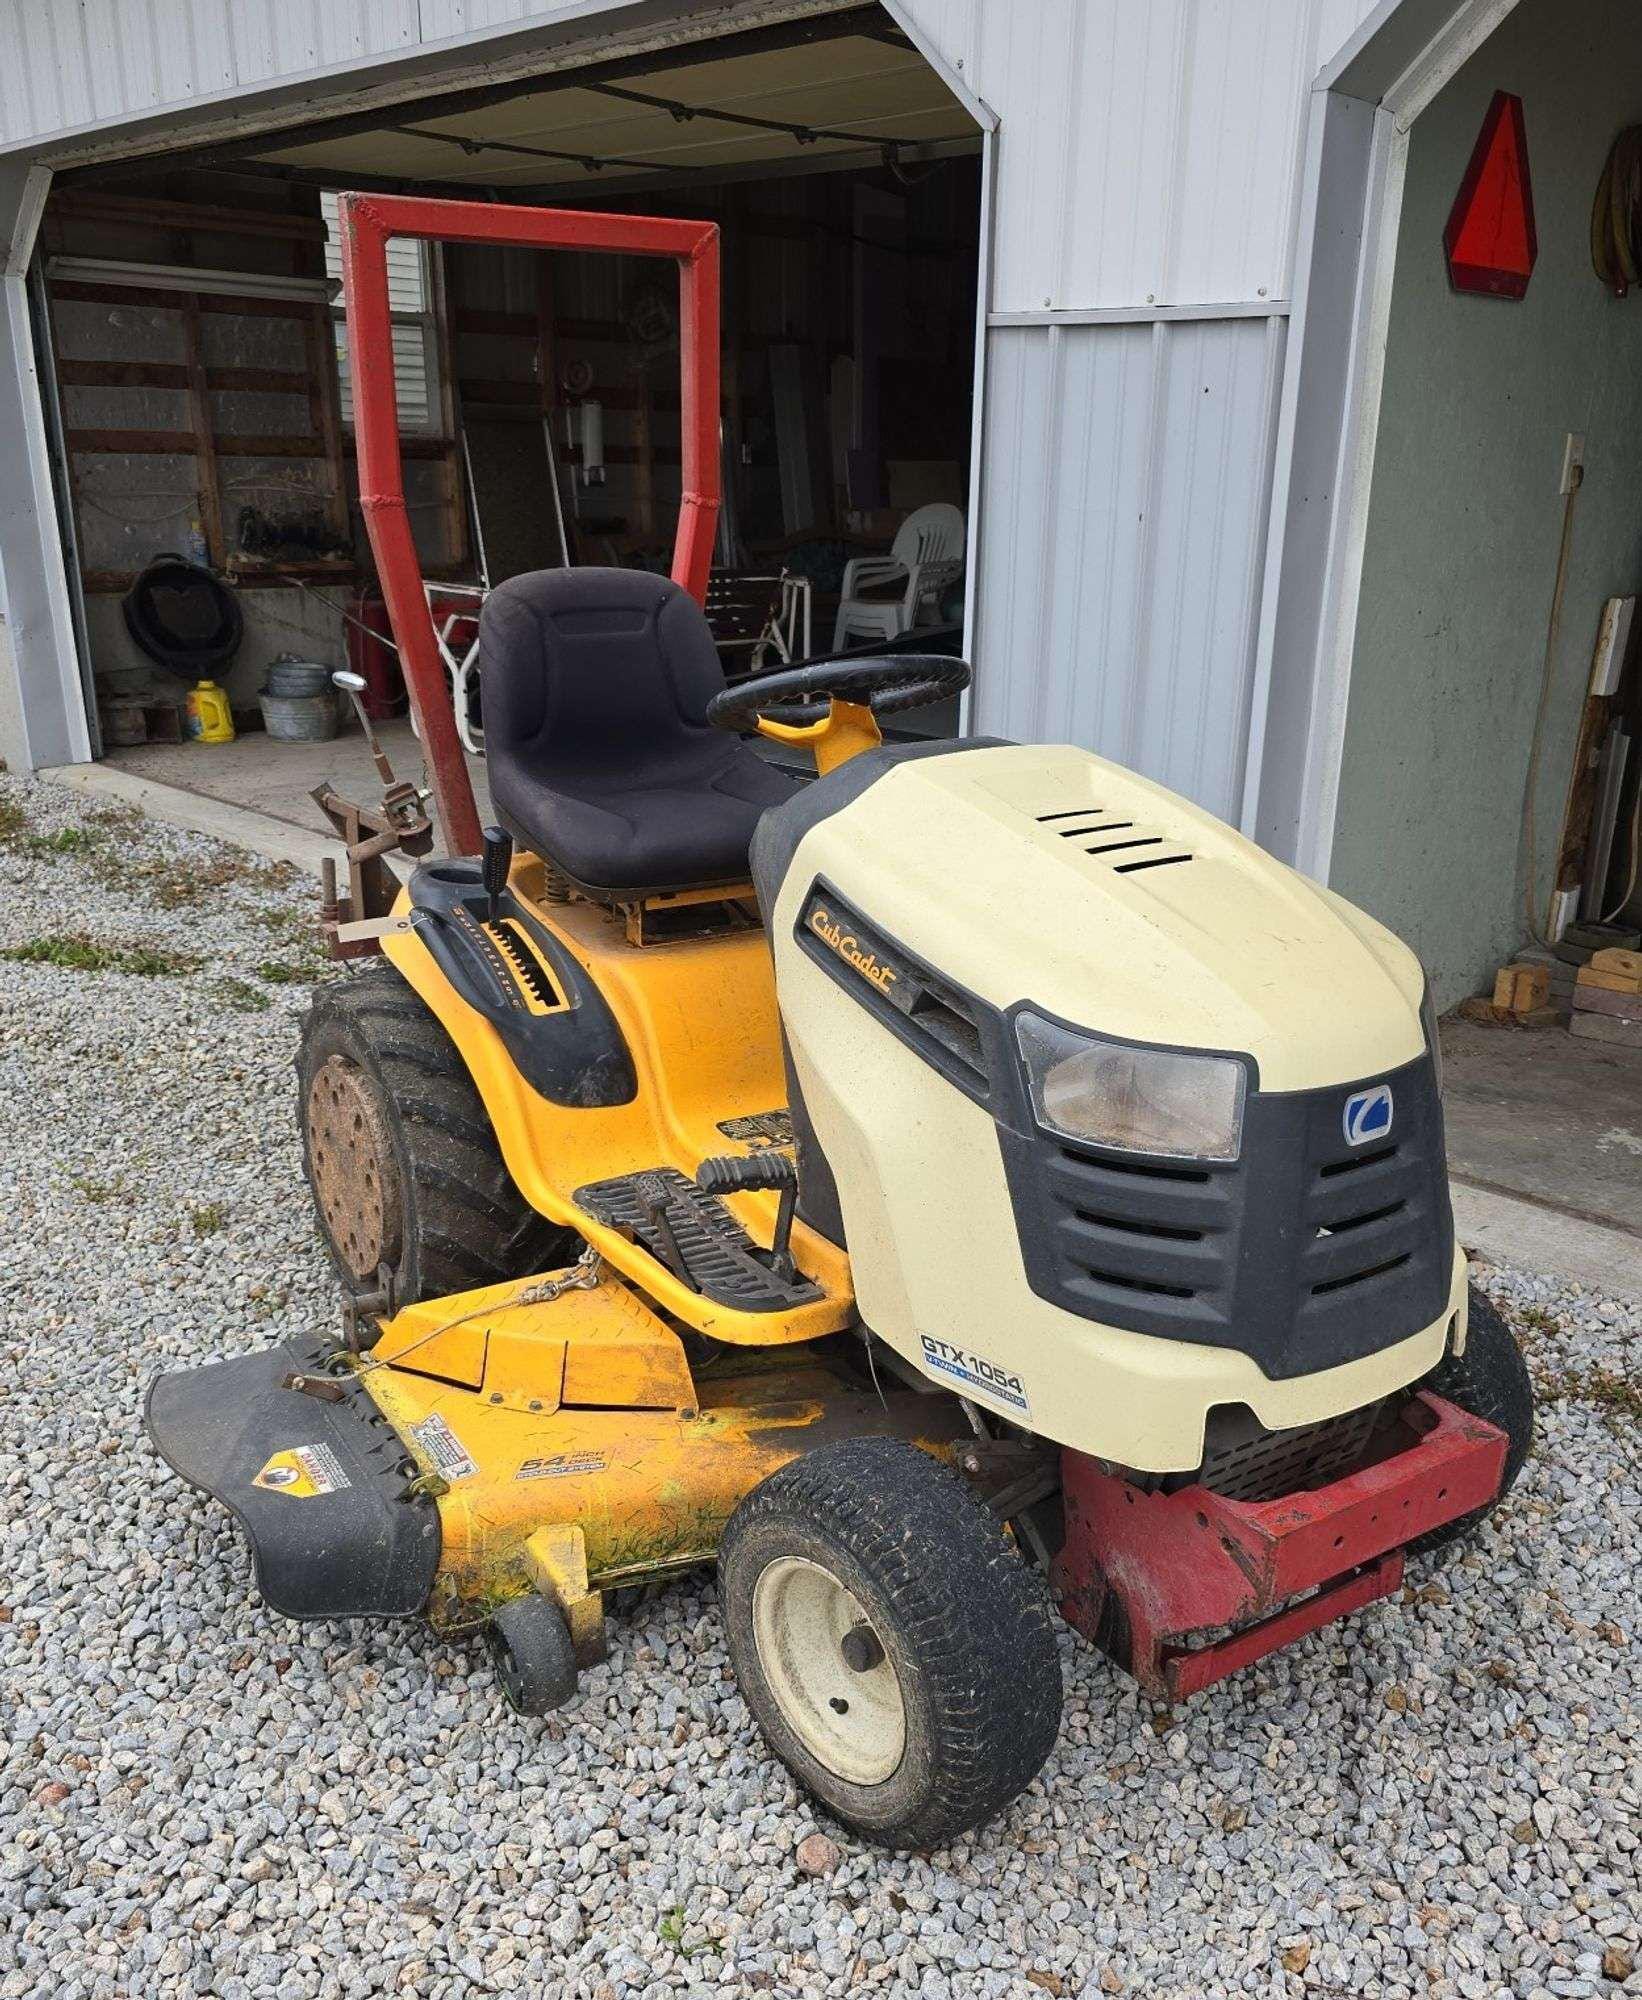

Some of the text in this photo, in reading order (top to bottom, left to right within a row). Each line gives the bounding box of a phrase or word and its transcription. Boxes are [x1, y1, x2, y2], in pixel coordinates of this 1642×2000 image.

[812, 911, 897, 993] Cub Cadet
[920, 1334, 1023, 1394] GTX 1054
[519, 1455, 566, 1471] 54
